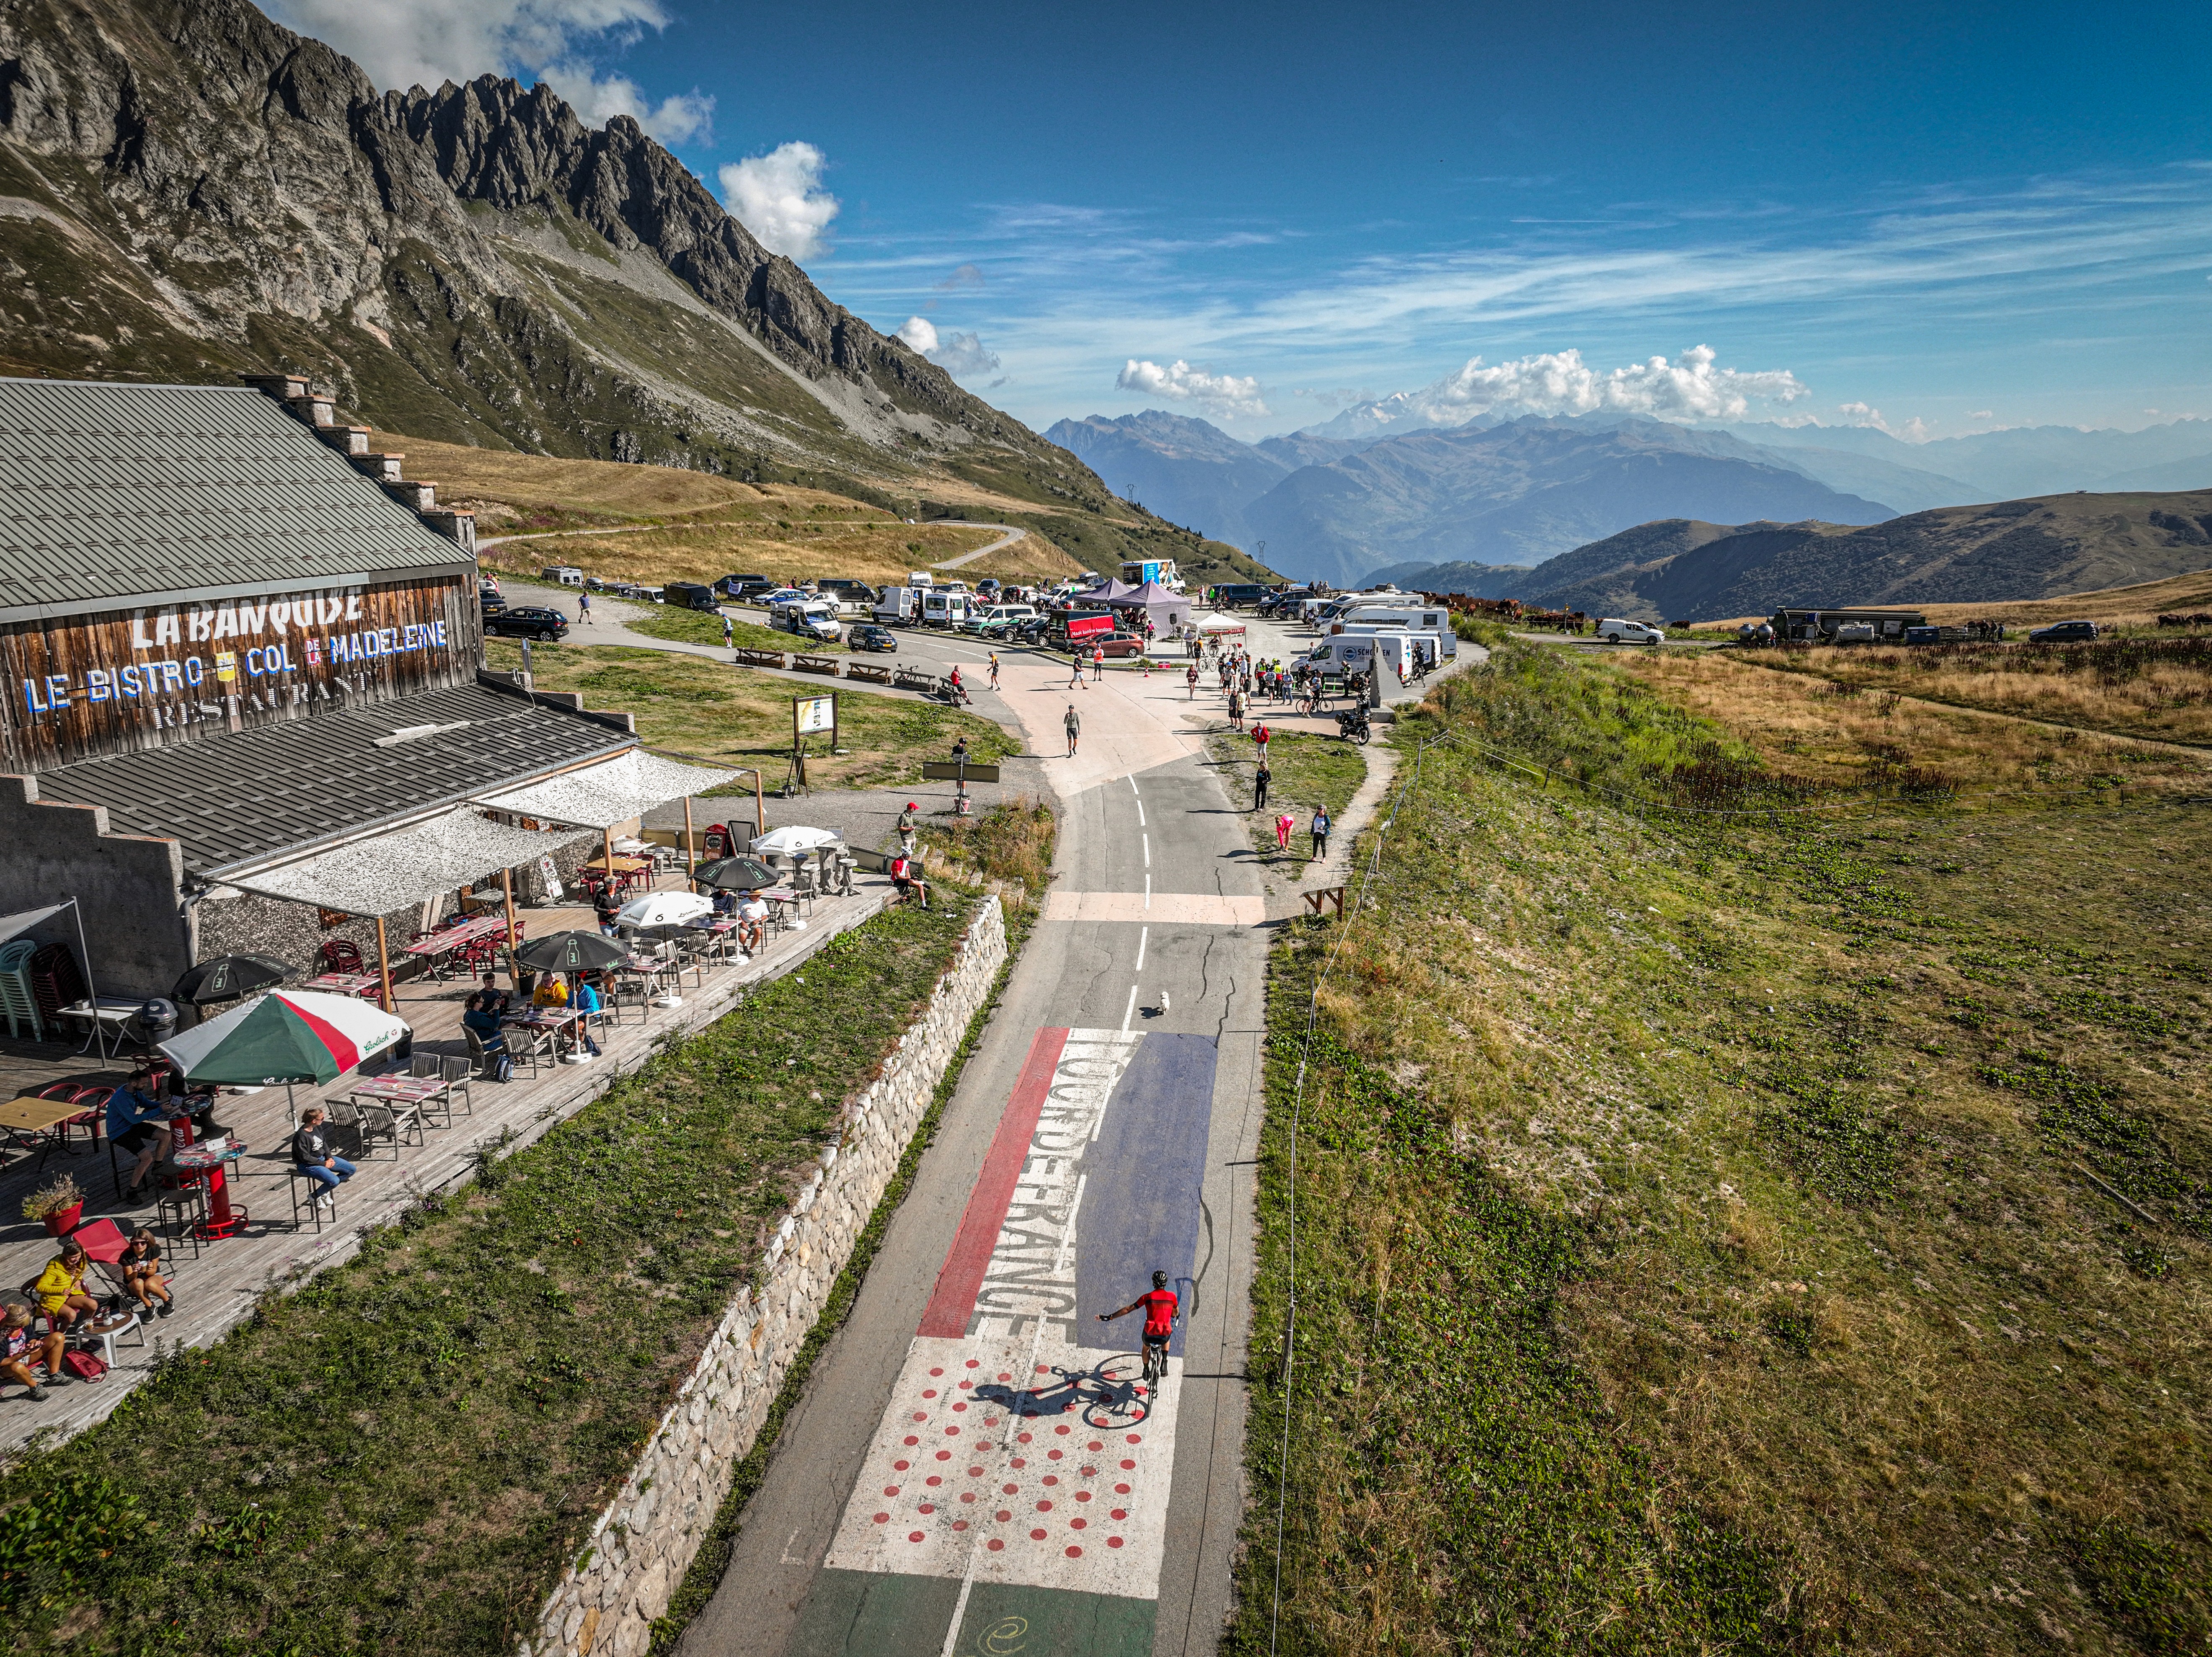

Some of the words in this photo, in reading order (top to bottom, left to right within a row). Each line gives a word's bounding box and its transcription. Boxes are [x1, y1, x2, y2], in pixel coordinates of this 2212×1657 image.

[133, 604, 181, 648] LA
[330, 620, 447, 664] MADELEINE
[245, 643, 297, 677] COL
[306, 639, 320, 653] DE
[307, 652, 322, 665] LA
[87, 656, 203, 702] BISTRO
[218, 658, 235, 672] DU
[24, 674, 71, 713] LE
[153, 671, 372, 729] RESTAURANT
[364, 1031, 389, 1054] Grolsch
